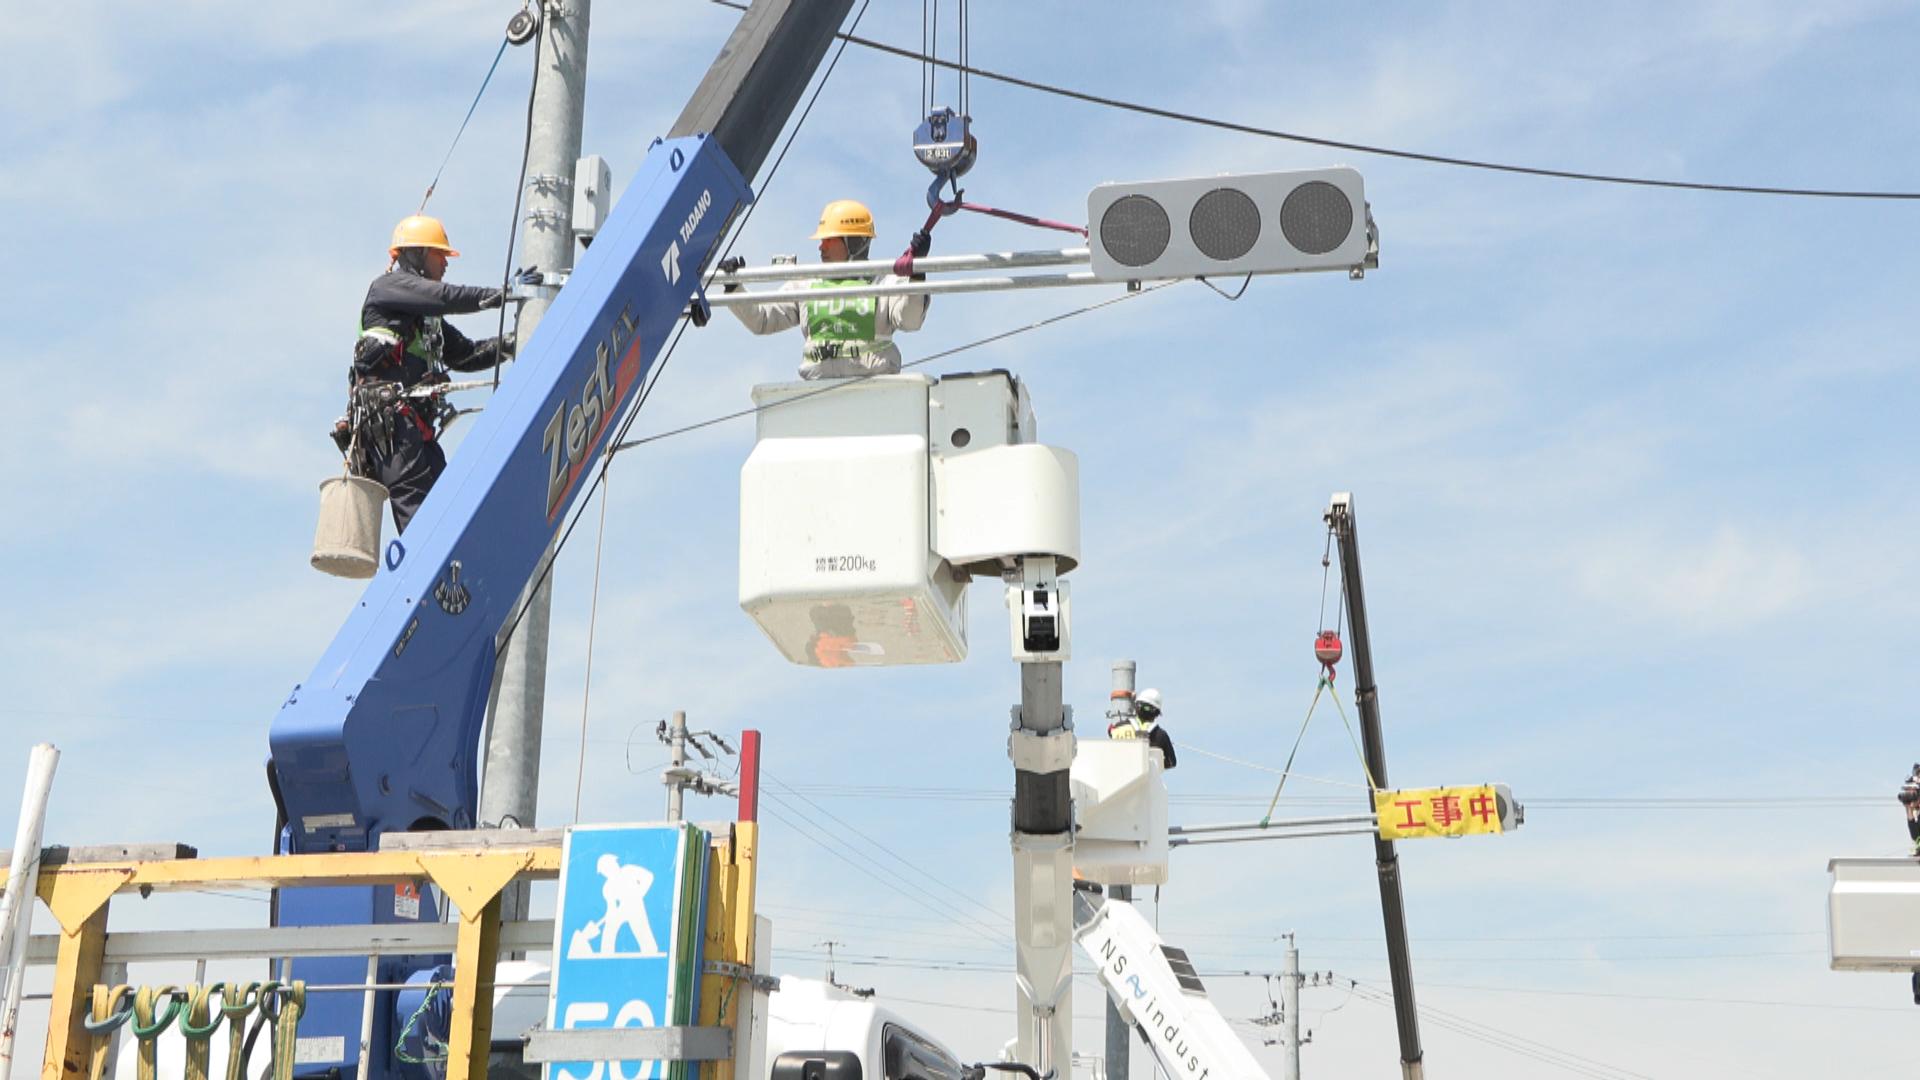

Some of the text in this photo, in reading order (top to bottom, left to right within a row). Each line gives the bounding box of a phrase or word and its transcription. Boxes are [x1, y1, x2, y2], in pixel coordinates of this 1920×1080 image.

[680, 189, 711, 244] TADANO
[542, 341, 615, 517] Zest
[1394, 793, 1496, 829] 工事中
[1101, 938, 1127, 975] NS
[556, 999, 656, 1080] 50
